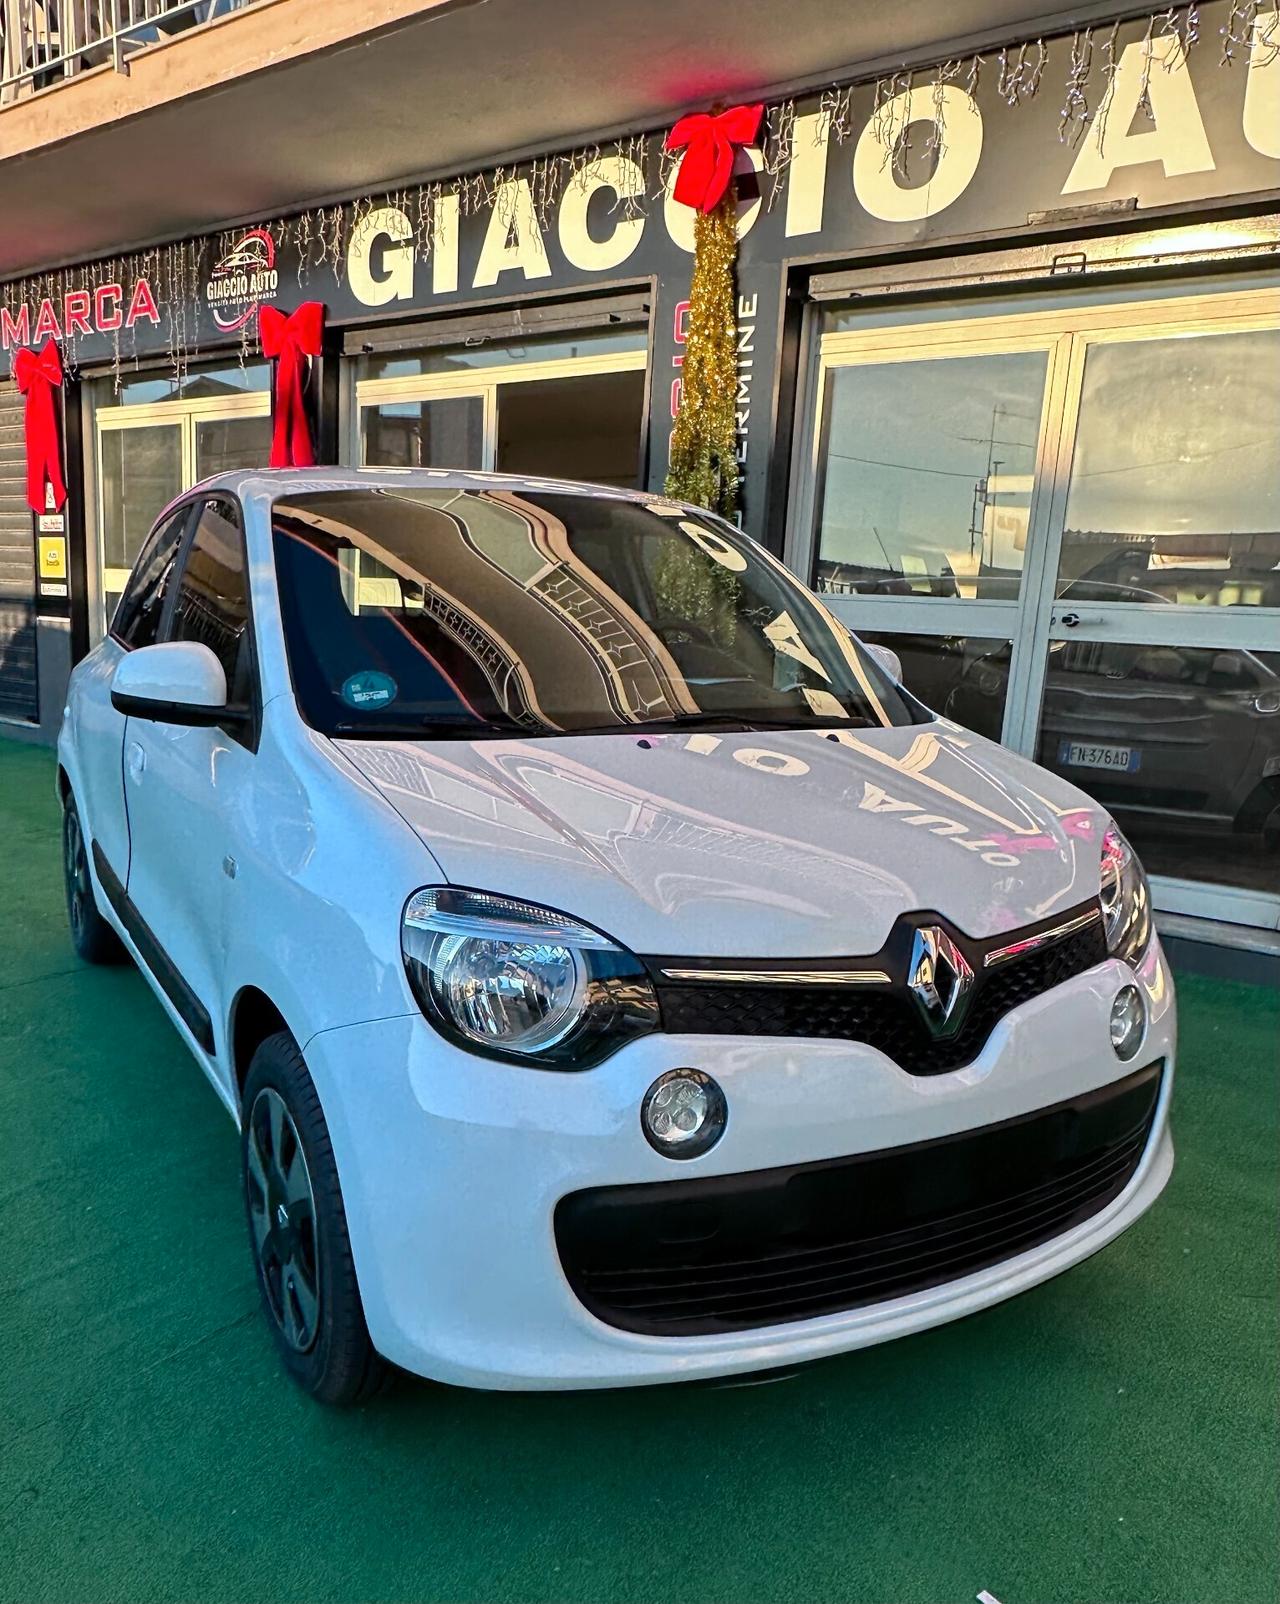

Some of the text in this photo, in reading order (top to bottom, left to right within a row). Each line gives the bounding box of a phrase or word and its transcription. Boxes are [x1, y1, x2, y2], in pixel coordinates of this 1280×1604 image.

[207, 269, 278, 300] GIACCIO AUTO
[1, 278, 161, 350] MARCA
